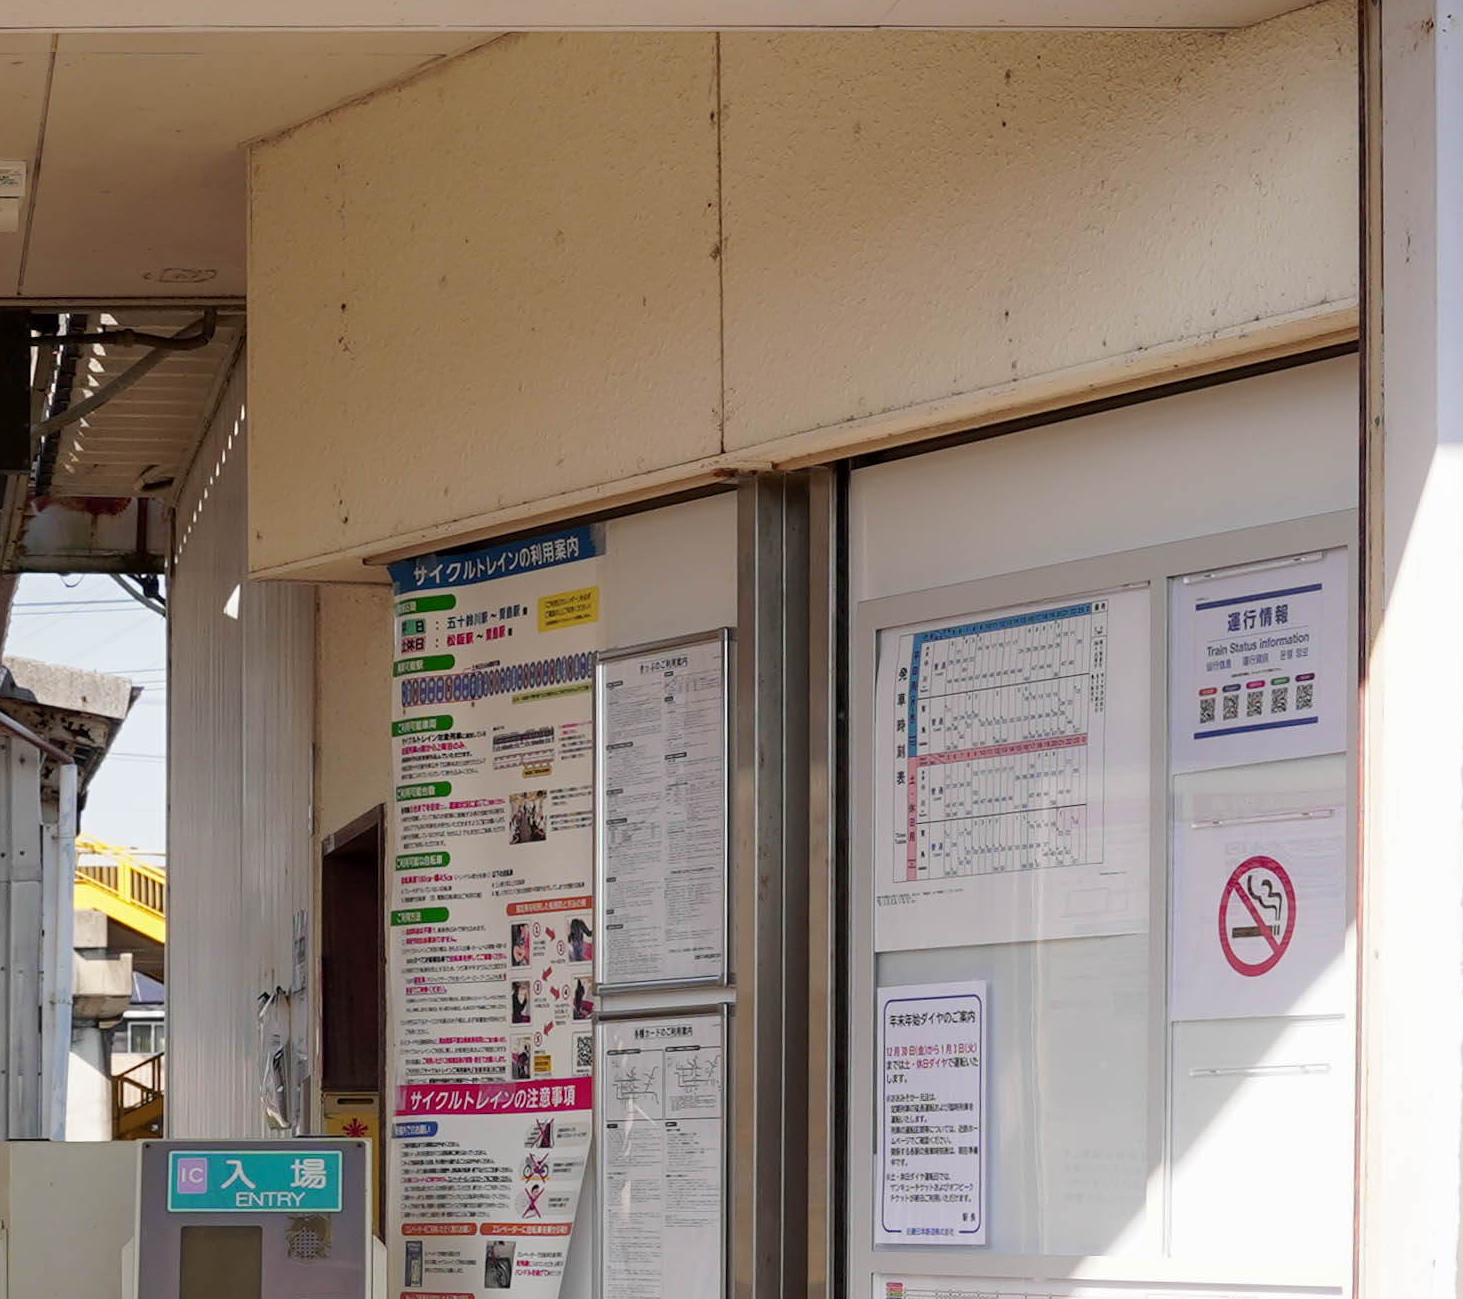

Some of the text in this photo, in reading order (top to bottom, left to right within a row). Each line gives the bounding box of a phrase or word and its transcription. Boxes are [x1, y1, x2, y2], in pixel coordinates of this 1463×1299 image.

[413, 536, 580, 586] サイクルトレインの利用案内
[1227, 603, 1289, 632] 運行情報
[1206, 632, 1310, 658] Train Status information
[410, 1084, 576, 1111] サイクルトレインの注意事項
[181, 1166, 205, 1184] IC
[219, 1158, 327, 1190] 入場
[235, 1191, 306, 1207] ENTRY
